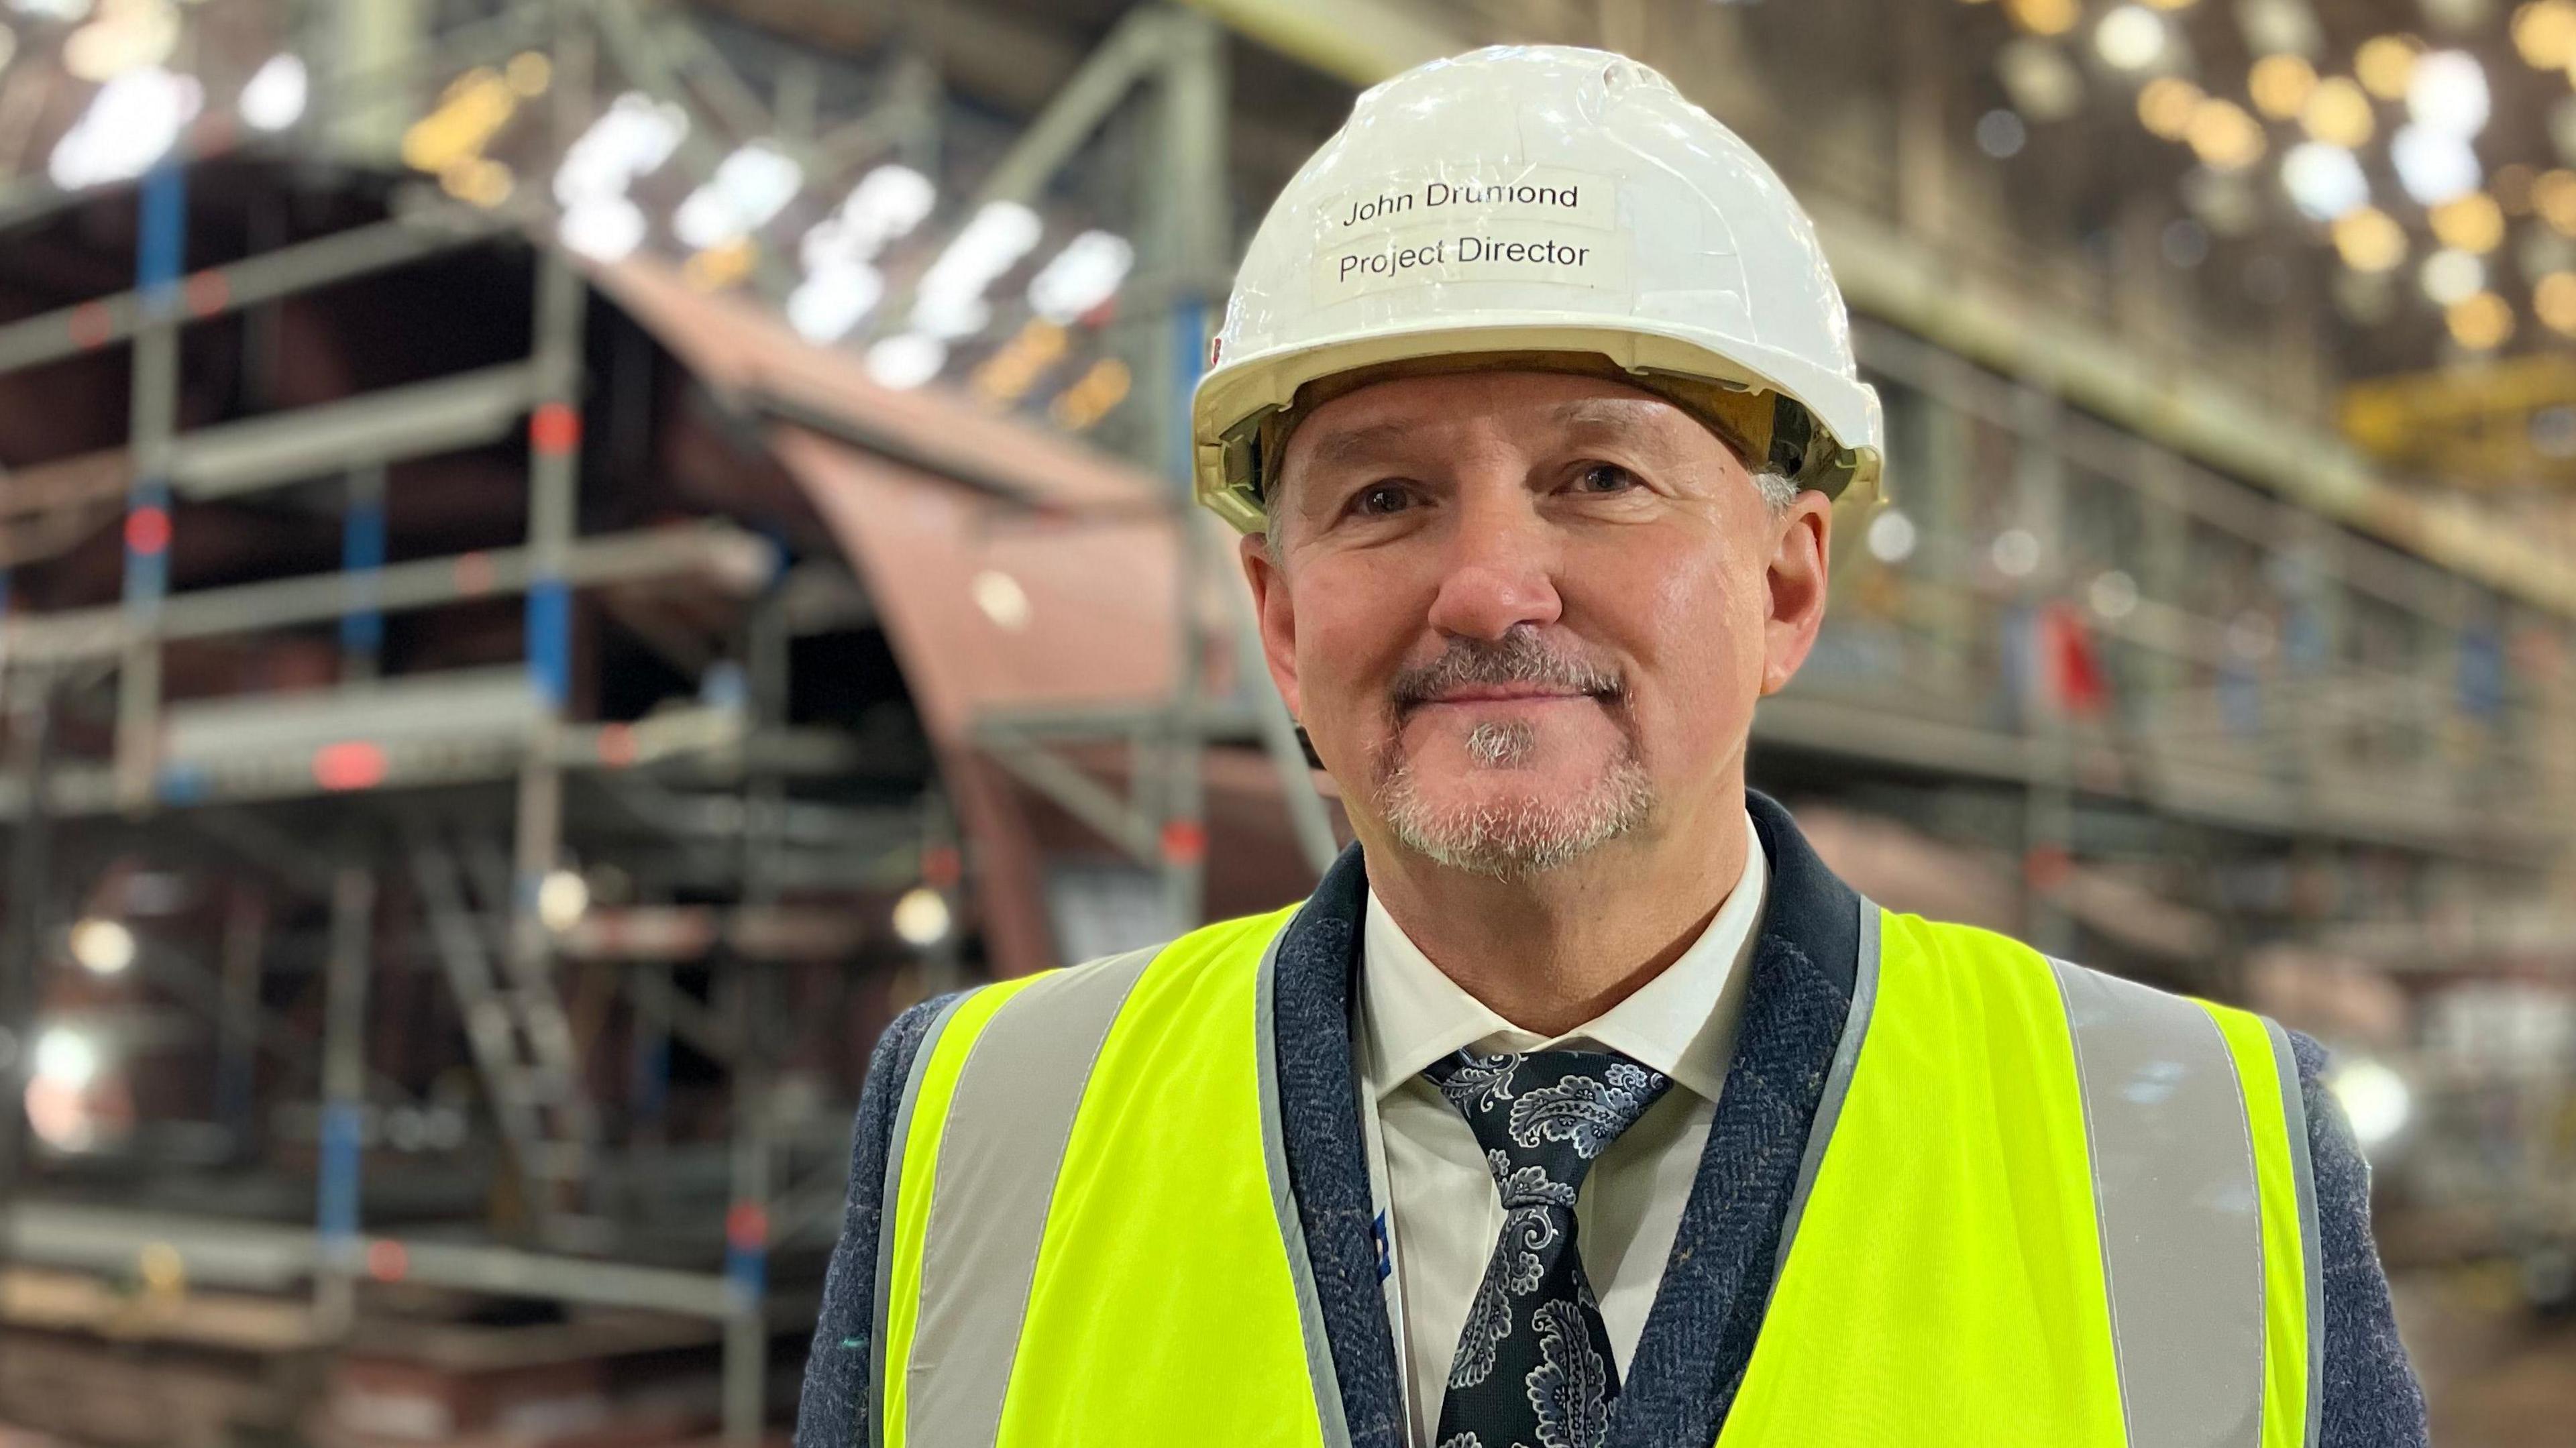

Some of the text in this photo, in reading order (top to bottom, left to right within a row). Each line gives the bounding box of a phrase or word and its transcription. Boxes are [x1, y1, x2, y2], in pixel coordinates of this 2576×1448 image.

[1343, 193, 1413, 227] John
[1340, 237, 1590, 282] Project Director
